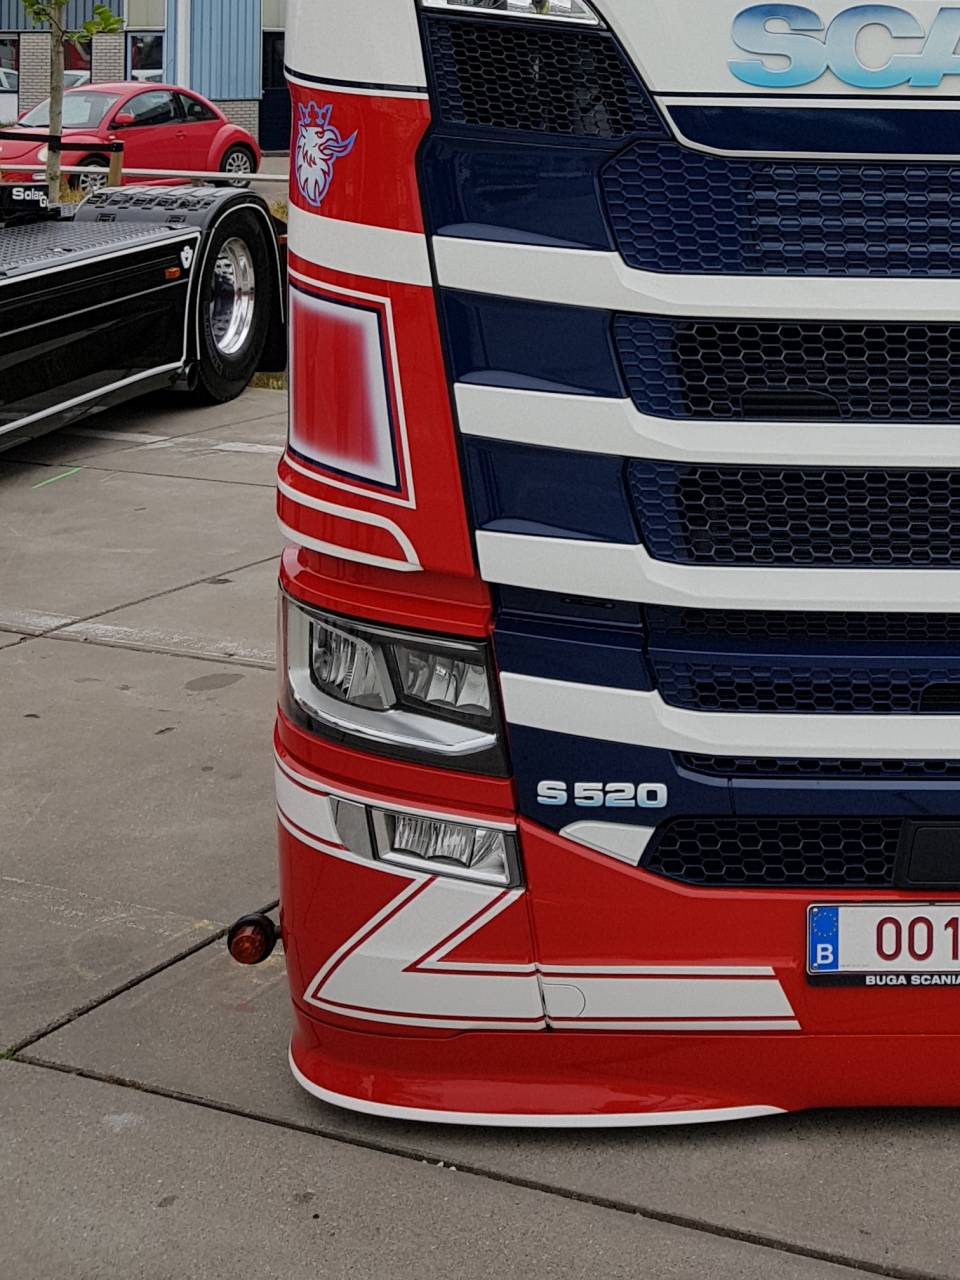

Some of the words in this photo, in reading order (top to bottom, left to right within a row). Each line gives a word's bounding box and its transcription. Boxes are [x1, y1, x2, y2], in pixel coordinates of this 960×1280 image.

[536, 780, 568, 807] S
[574, 782, 668, 808] 520
[816, 943, 834, 965] B
[865, 975, 907, 986] BUGA
